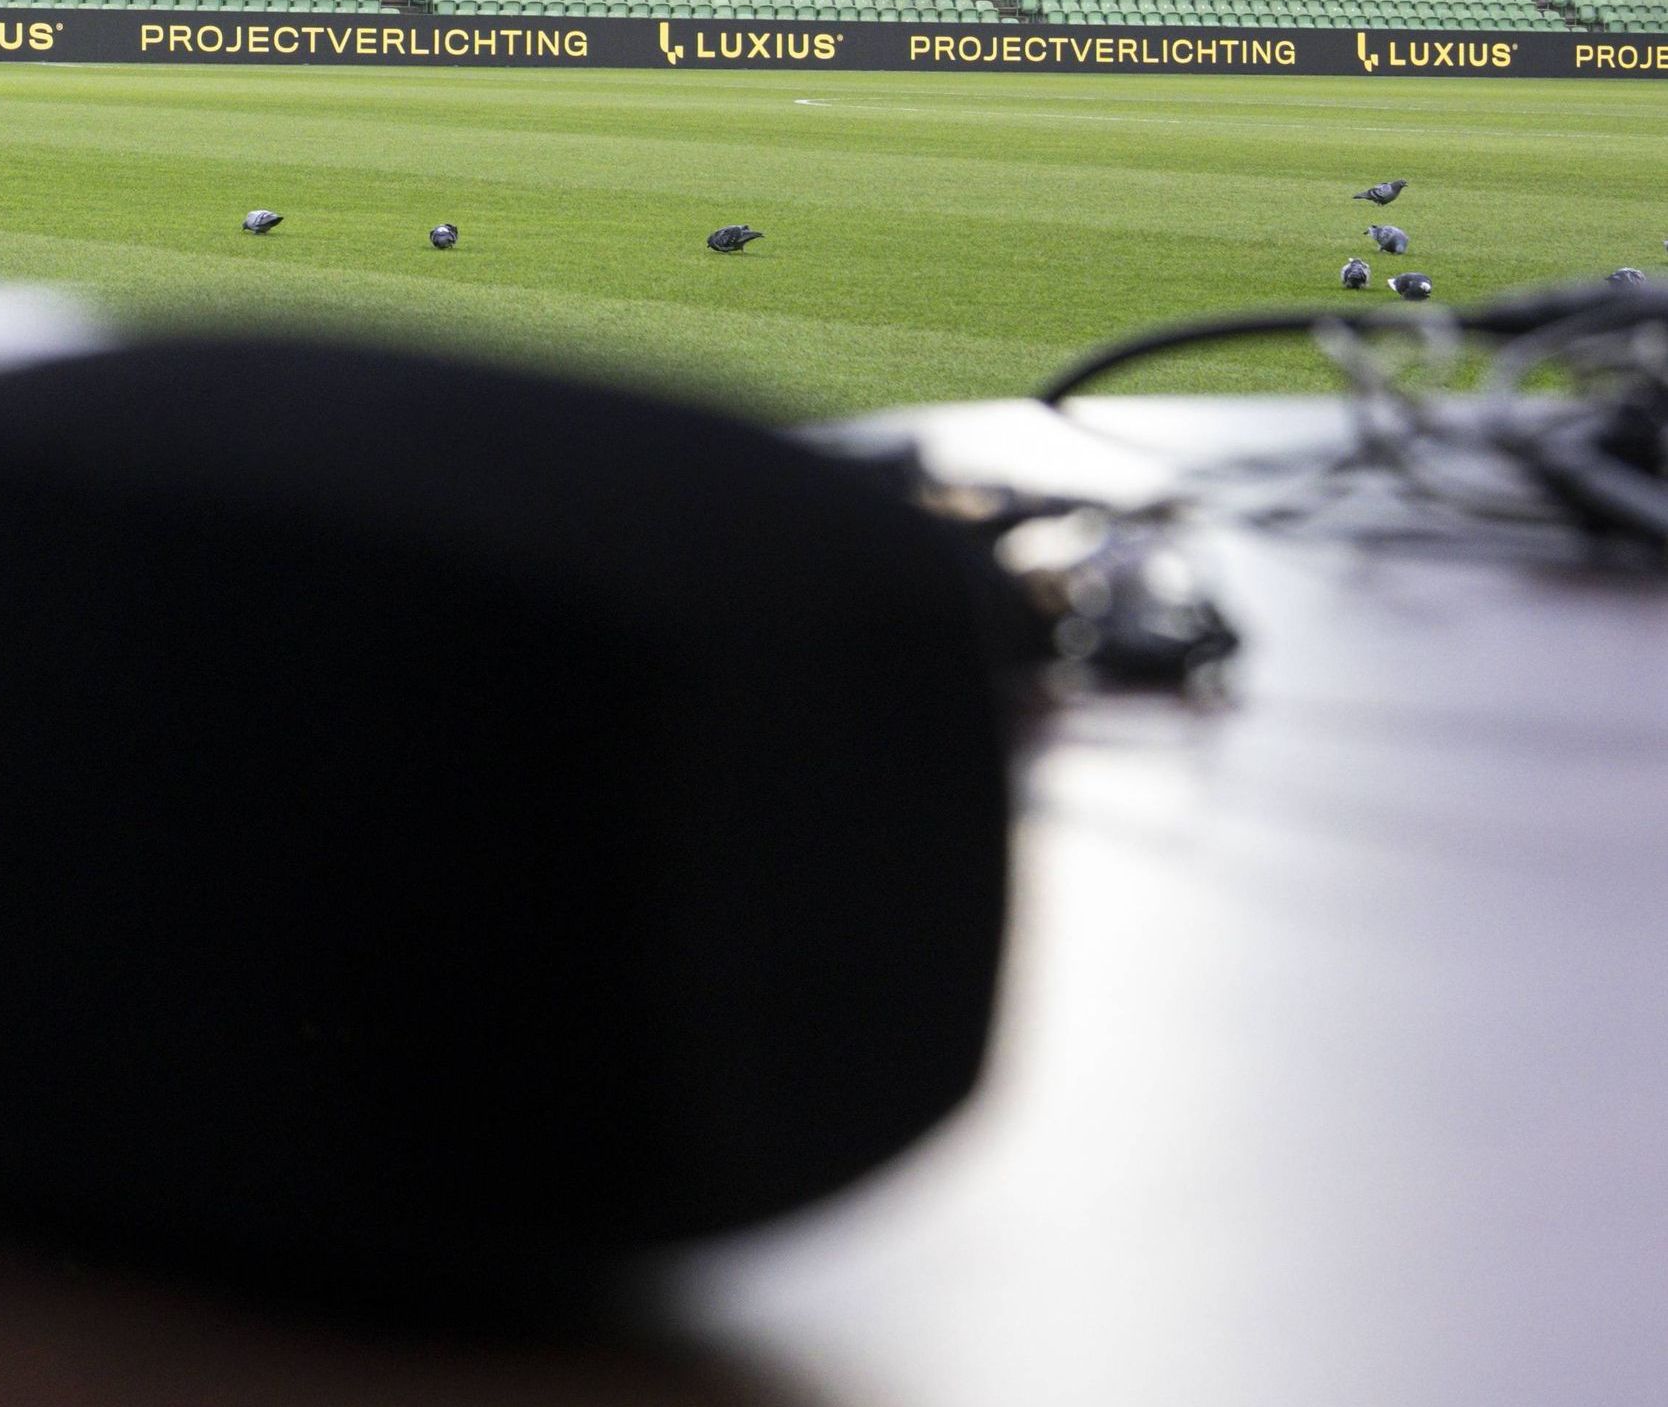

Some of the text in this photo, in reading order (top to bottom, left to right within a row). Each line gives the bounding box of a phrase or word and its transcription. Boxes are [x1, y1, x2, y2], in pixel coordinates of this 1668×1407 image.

[140, 24, 588, 57] PROJECTVERLICHTING
[910, 35, 1296, 65] PROJECTVERLICHTING
[1575, 44, 1668, 70] PROJE
